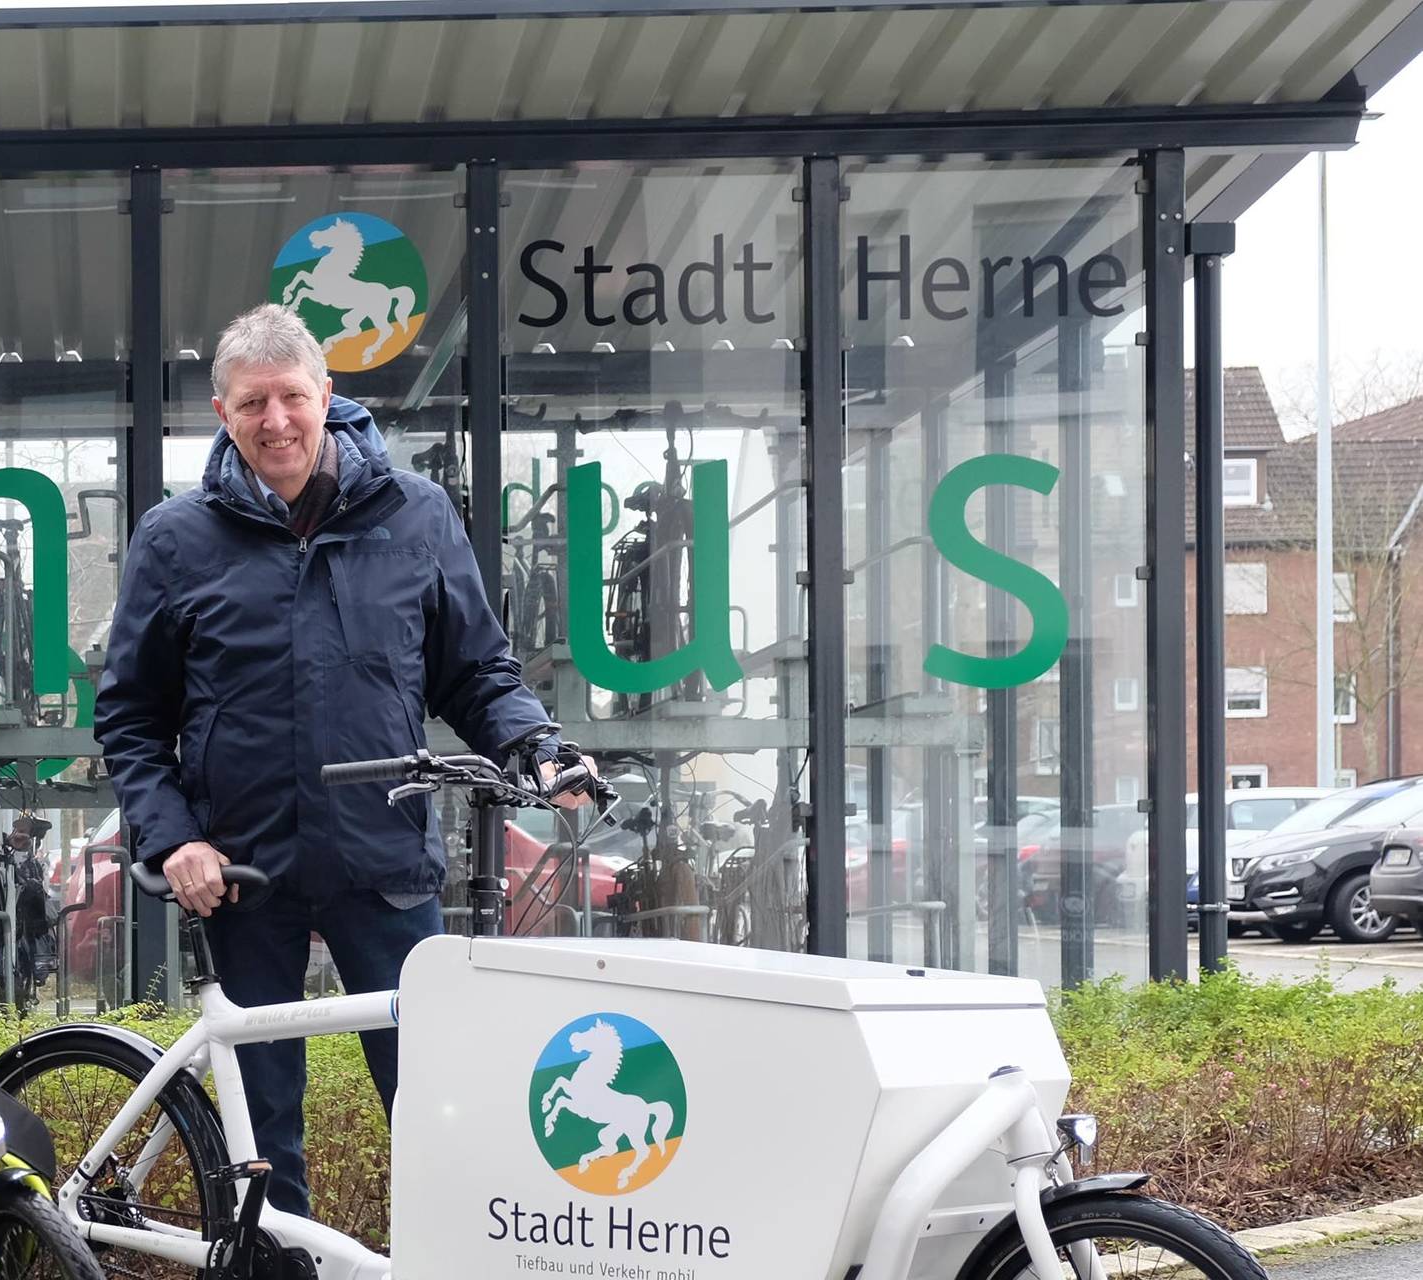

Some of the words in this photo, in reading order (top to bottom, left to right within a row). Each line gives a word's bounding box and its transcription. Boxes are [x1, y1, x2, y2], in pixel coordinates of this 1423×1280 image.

[517, 233, 777, 328] Stadt
[856, 234, 1128, 321] Herne
[488, 1197, 595, 1248] Stadt
[608, 1206, 731, 1259] Herne
[515, 1254, 564, 1273] Tiefbau
[569, 1260, 594, 1276] und
[599, 1262, 651, 1280] Verkehr
